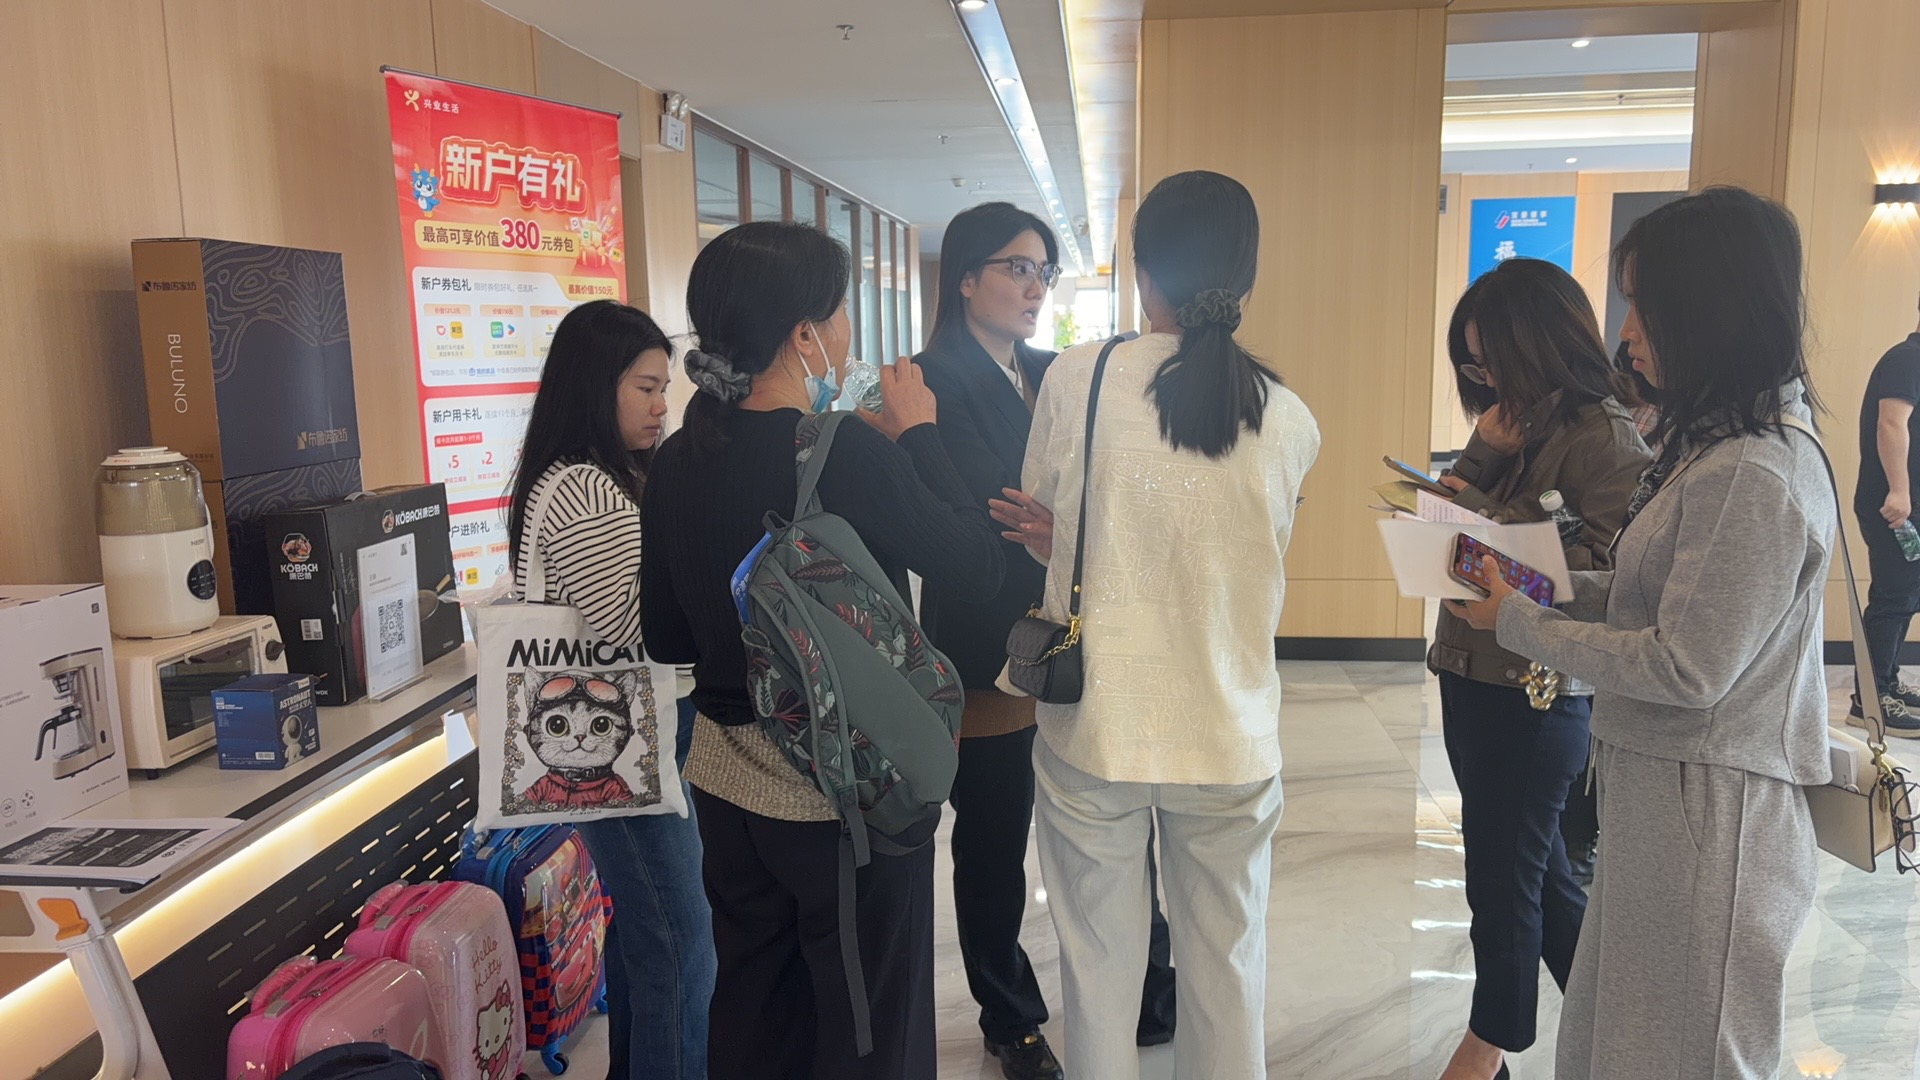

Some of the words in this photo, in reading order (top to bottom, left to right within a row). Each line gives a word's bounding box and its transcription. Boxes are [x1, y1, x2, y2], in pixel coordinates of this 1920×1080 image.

[446, 144, 580, 202] 新户有礼
[421, 276, 471, 292] 新户券包礼
[568, 284, 614, 296] 最高价值150元
[167, 334, 188, 414] BULUNO
[432, 408, 482, 423] 新户用卡礼
[280, 563, 318, 573] KÖBACH
[280, 689, 311, 709] ASTRONAUT
[471, 936, 498, 972] Hello
[474, 957, 502, 994] Kitty
